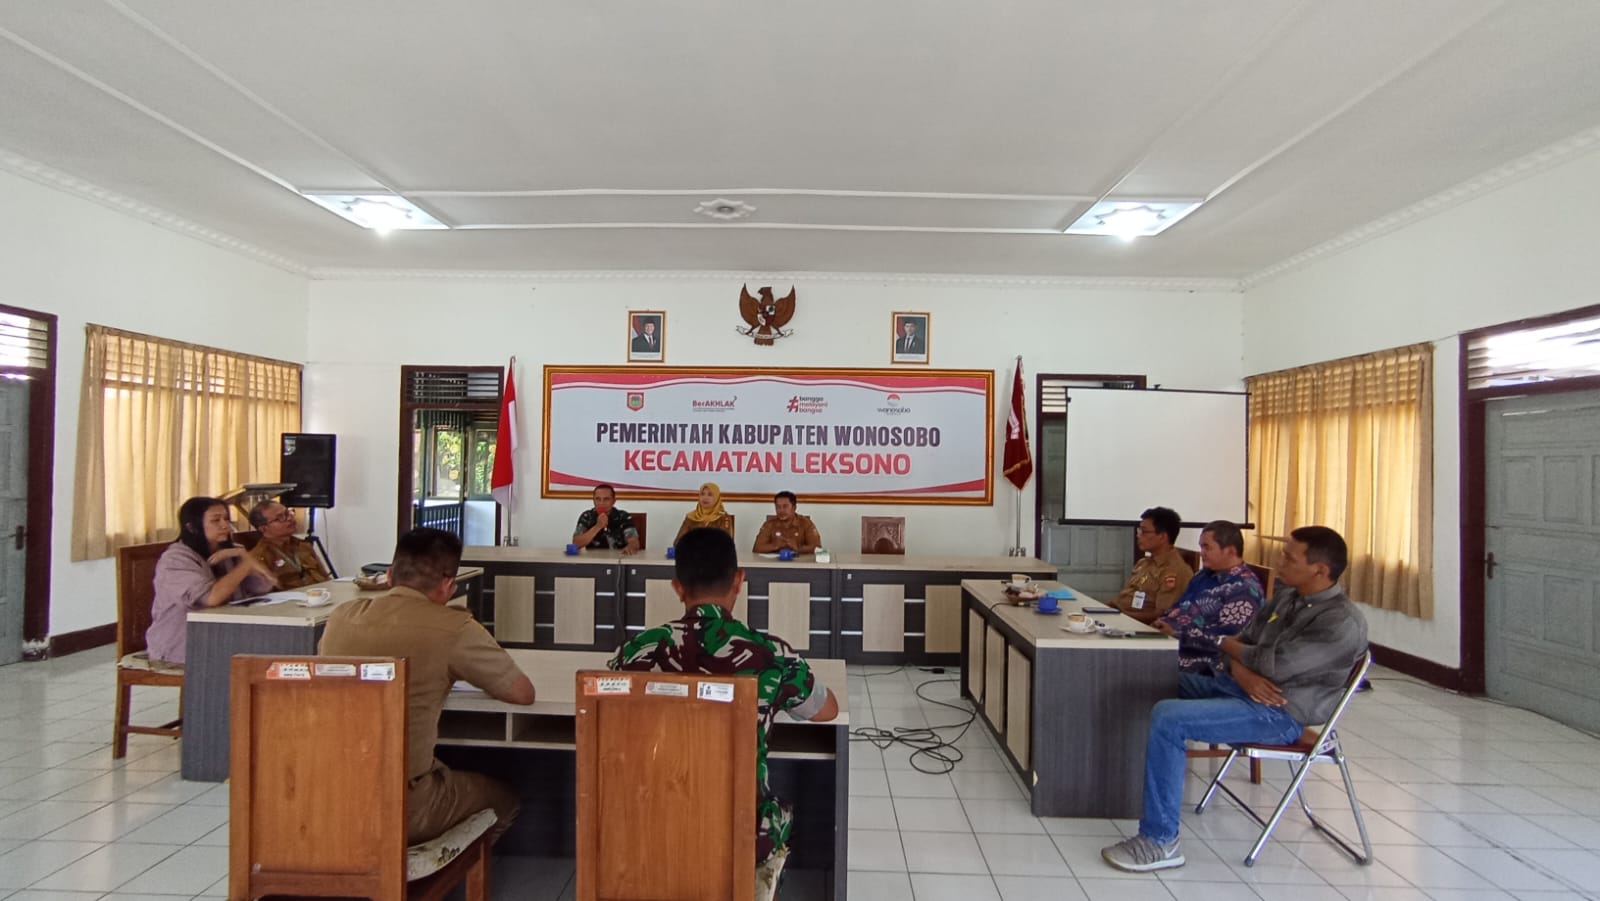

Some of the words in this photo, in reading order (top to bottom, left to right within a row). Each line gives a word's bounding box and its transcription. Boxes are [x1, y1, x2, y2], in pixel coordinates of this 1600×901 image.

[692, 398, 736, 408] BerAKHLAK
[596, 422, 714, 445] PEMERINTAH
[718, 423, 829, 446] KABUPATEN
[834, 425, 941, 448] WONOSOBO
[624, 449, 783, 474] KECAMATAN
[790, 451, 911, 475] LEKSONO
